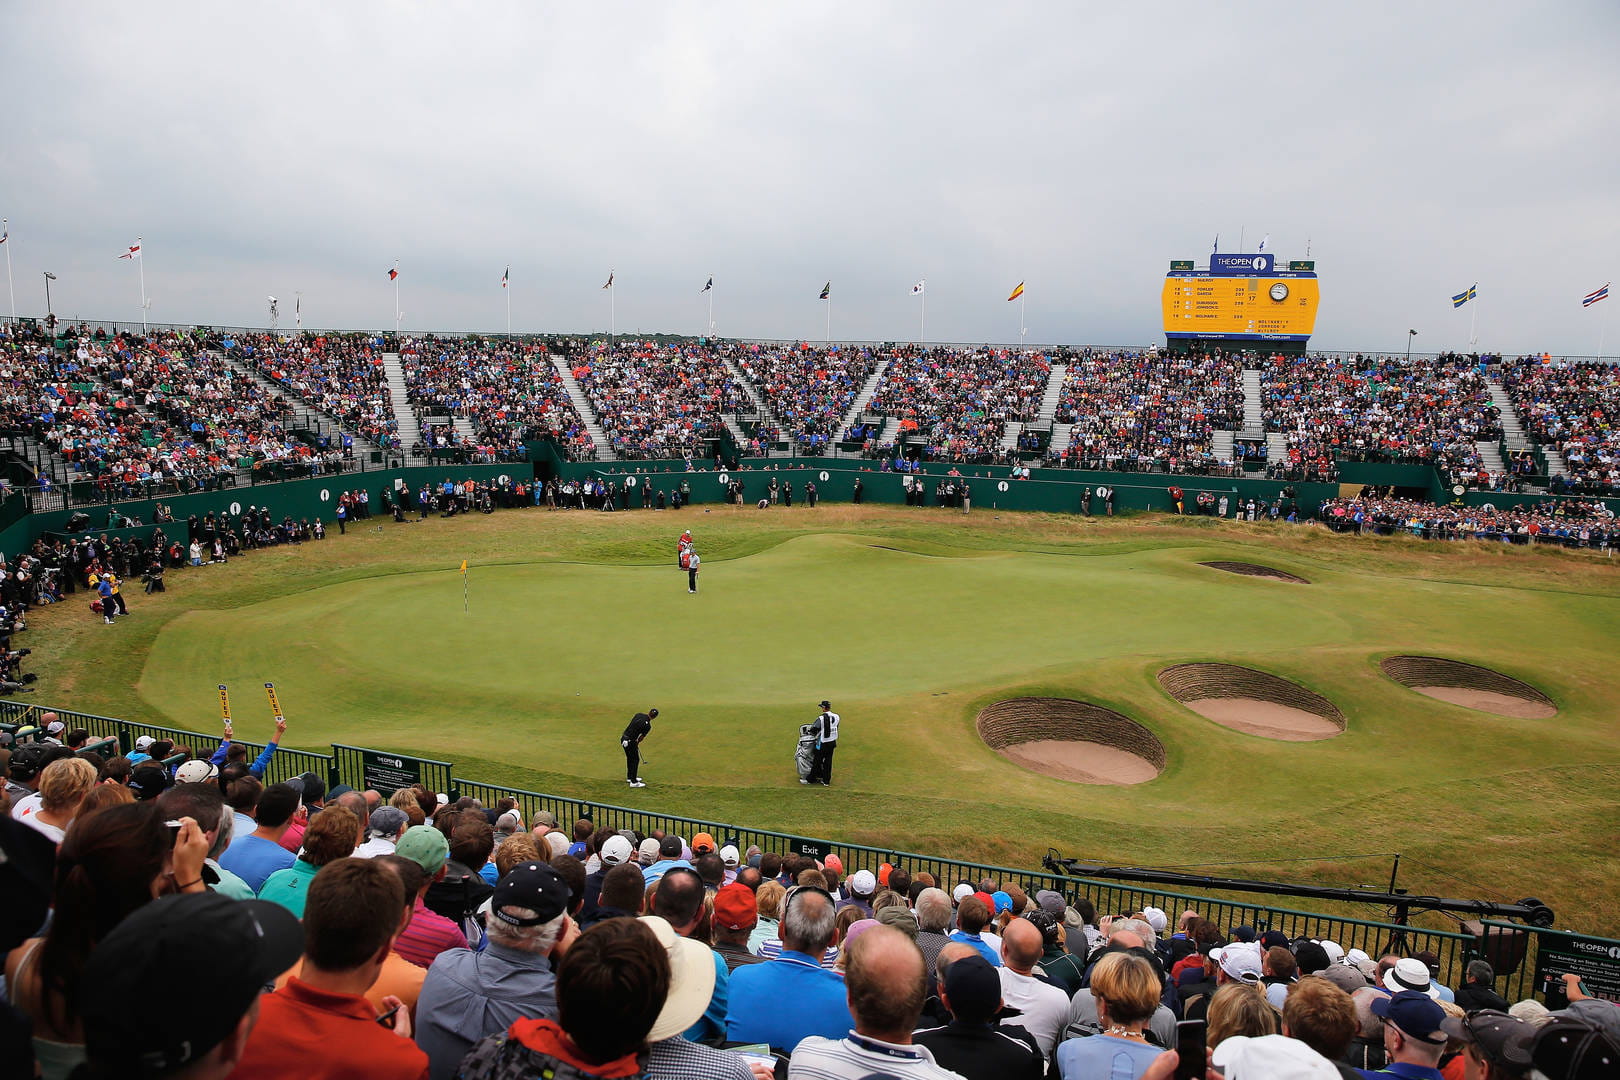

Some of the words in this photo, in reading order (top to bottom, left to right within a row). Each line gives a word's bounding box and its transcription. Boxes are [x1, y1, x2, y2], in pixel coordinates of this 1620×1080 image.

[802, 844, 819, 856] Exit
[1572, 941, 1586, 950] THE
[1585, 943, 1608, 953] OPEN
[1557, 955, 1577, 963] Standing
